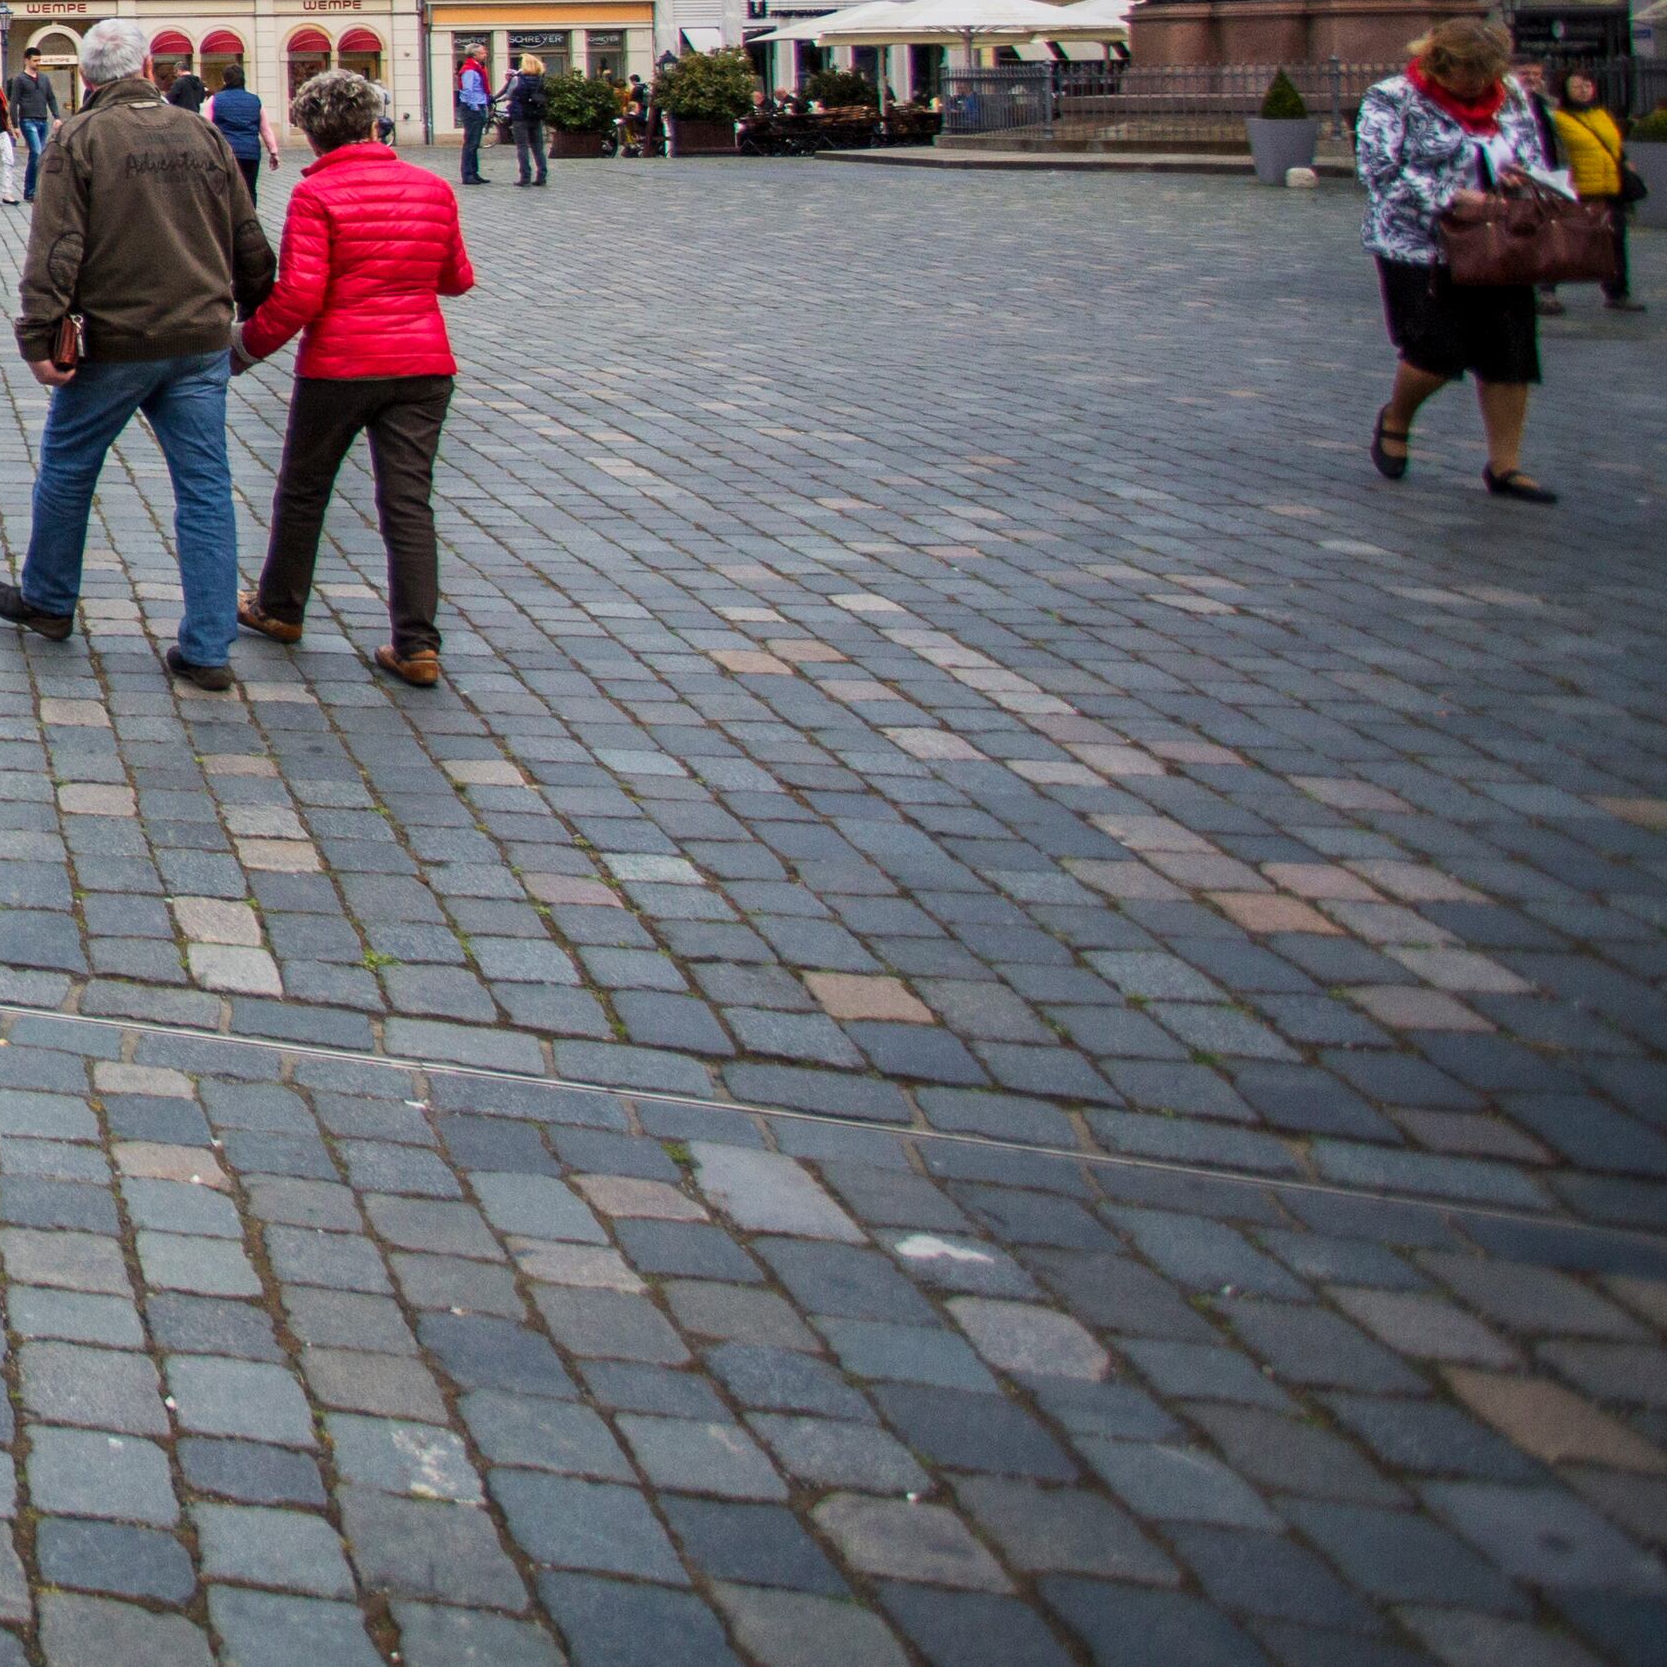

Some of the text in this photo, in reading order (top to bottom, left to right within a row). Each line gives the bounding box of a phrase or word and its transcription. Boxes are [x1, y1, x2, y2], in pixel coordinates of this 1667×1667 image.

[26, 3, 87, 14] WEMPE
[303, 0, 362, 11] WEMPE
[508, 35, 564, 47] SCHREYER
